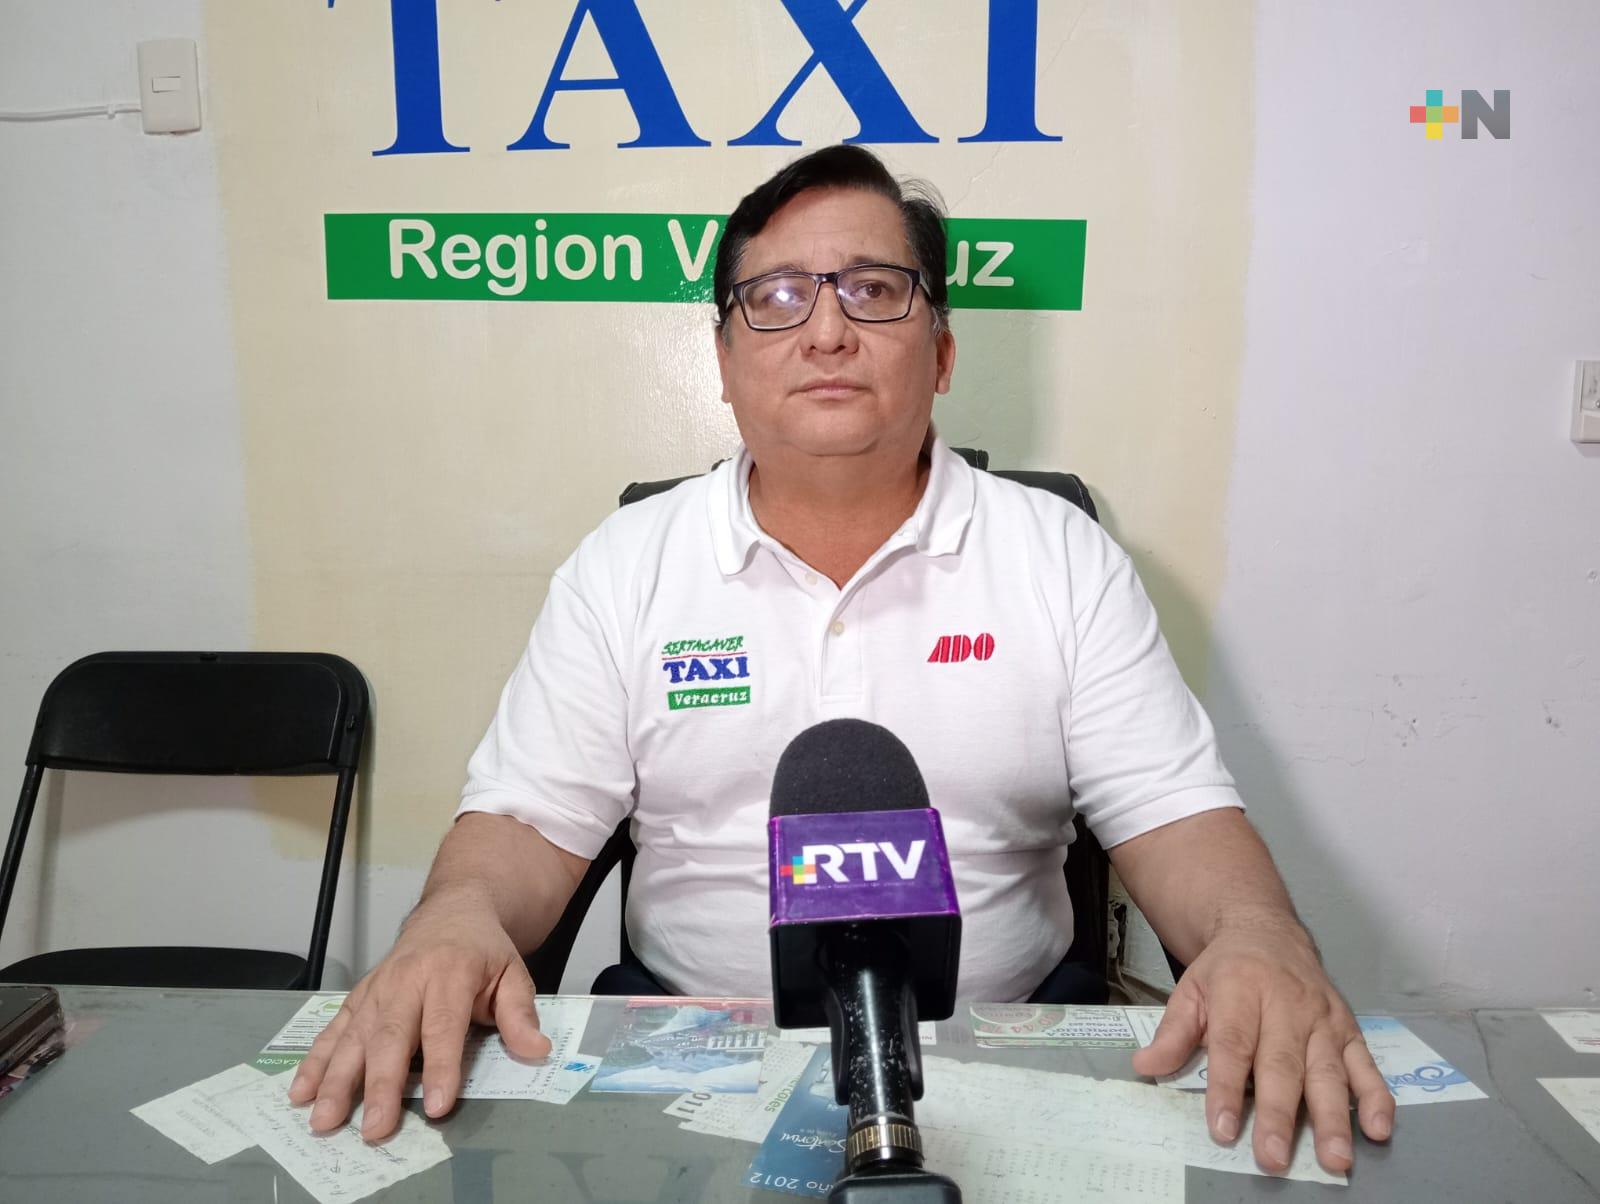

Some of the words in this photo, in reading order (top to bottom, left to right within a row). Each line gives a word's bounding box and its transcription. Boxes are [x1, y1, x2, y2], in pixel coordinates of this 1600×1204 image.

[328, 0, 1063, 156] TAXI
[389, 218, 644, 296] Region
[661, 635, 744, 656] SERTACAVER
[927, 632, 996, 664] ADO
[662, 656, 751, 684] TAXI
[674, 691, 748, 706] Veracruz
[802, 839, 926, 885] RTV
[676, 1093, 712, 1114] 011
[749, 1172, 799, 1190] 2012
[806, 1181, 833, 1193] ño
